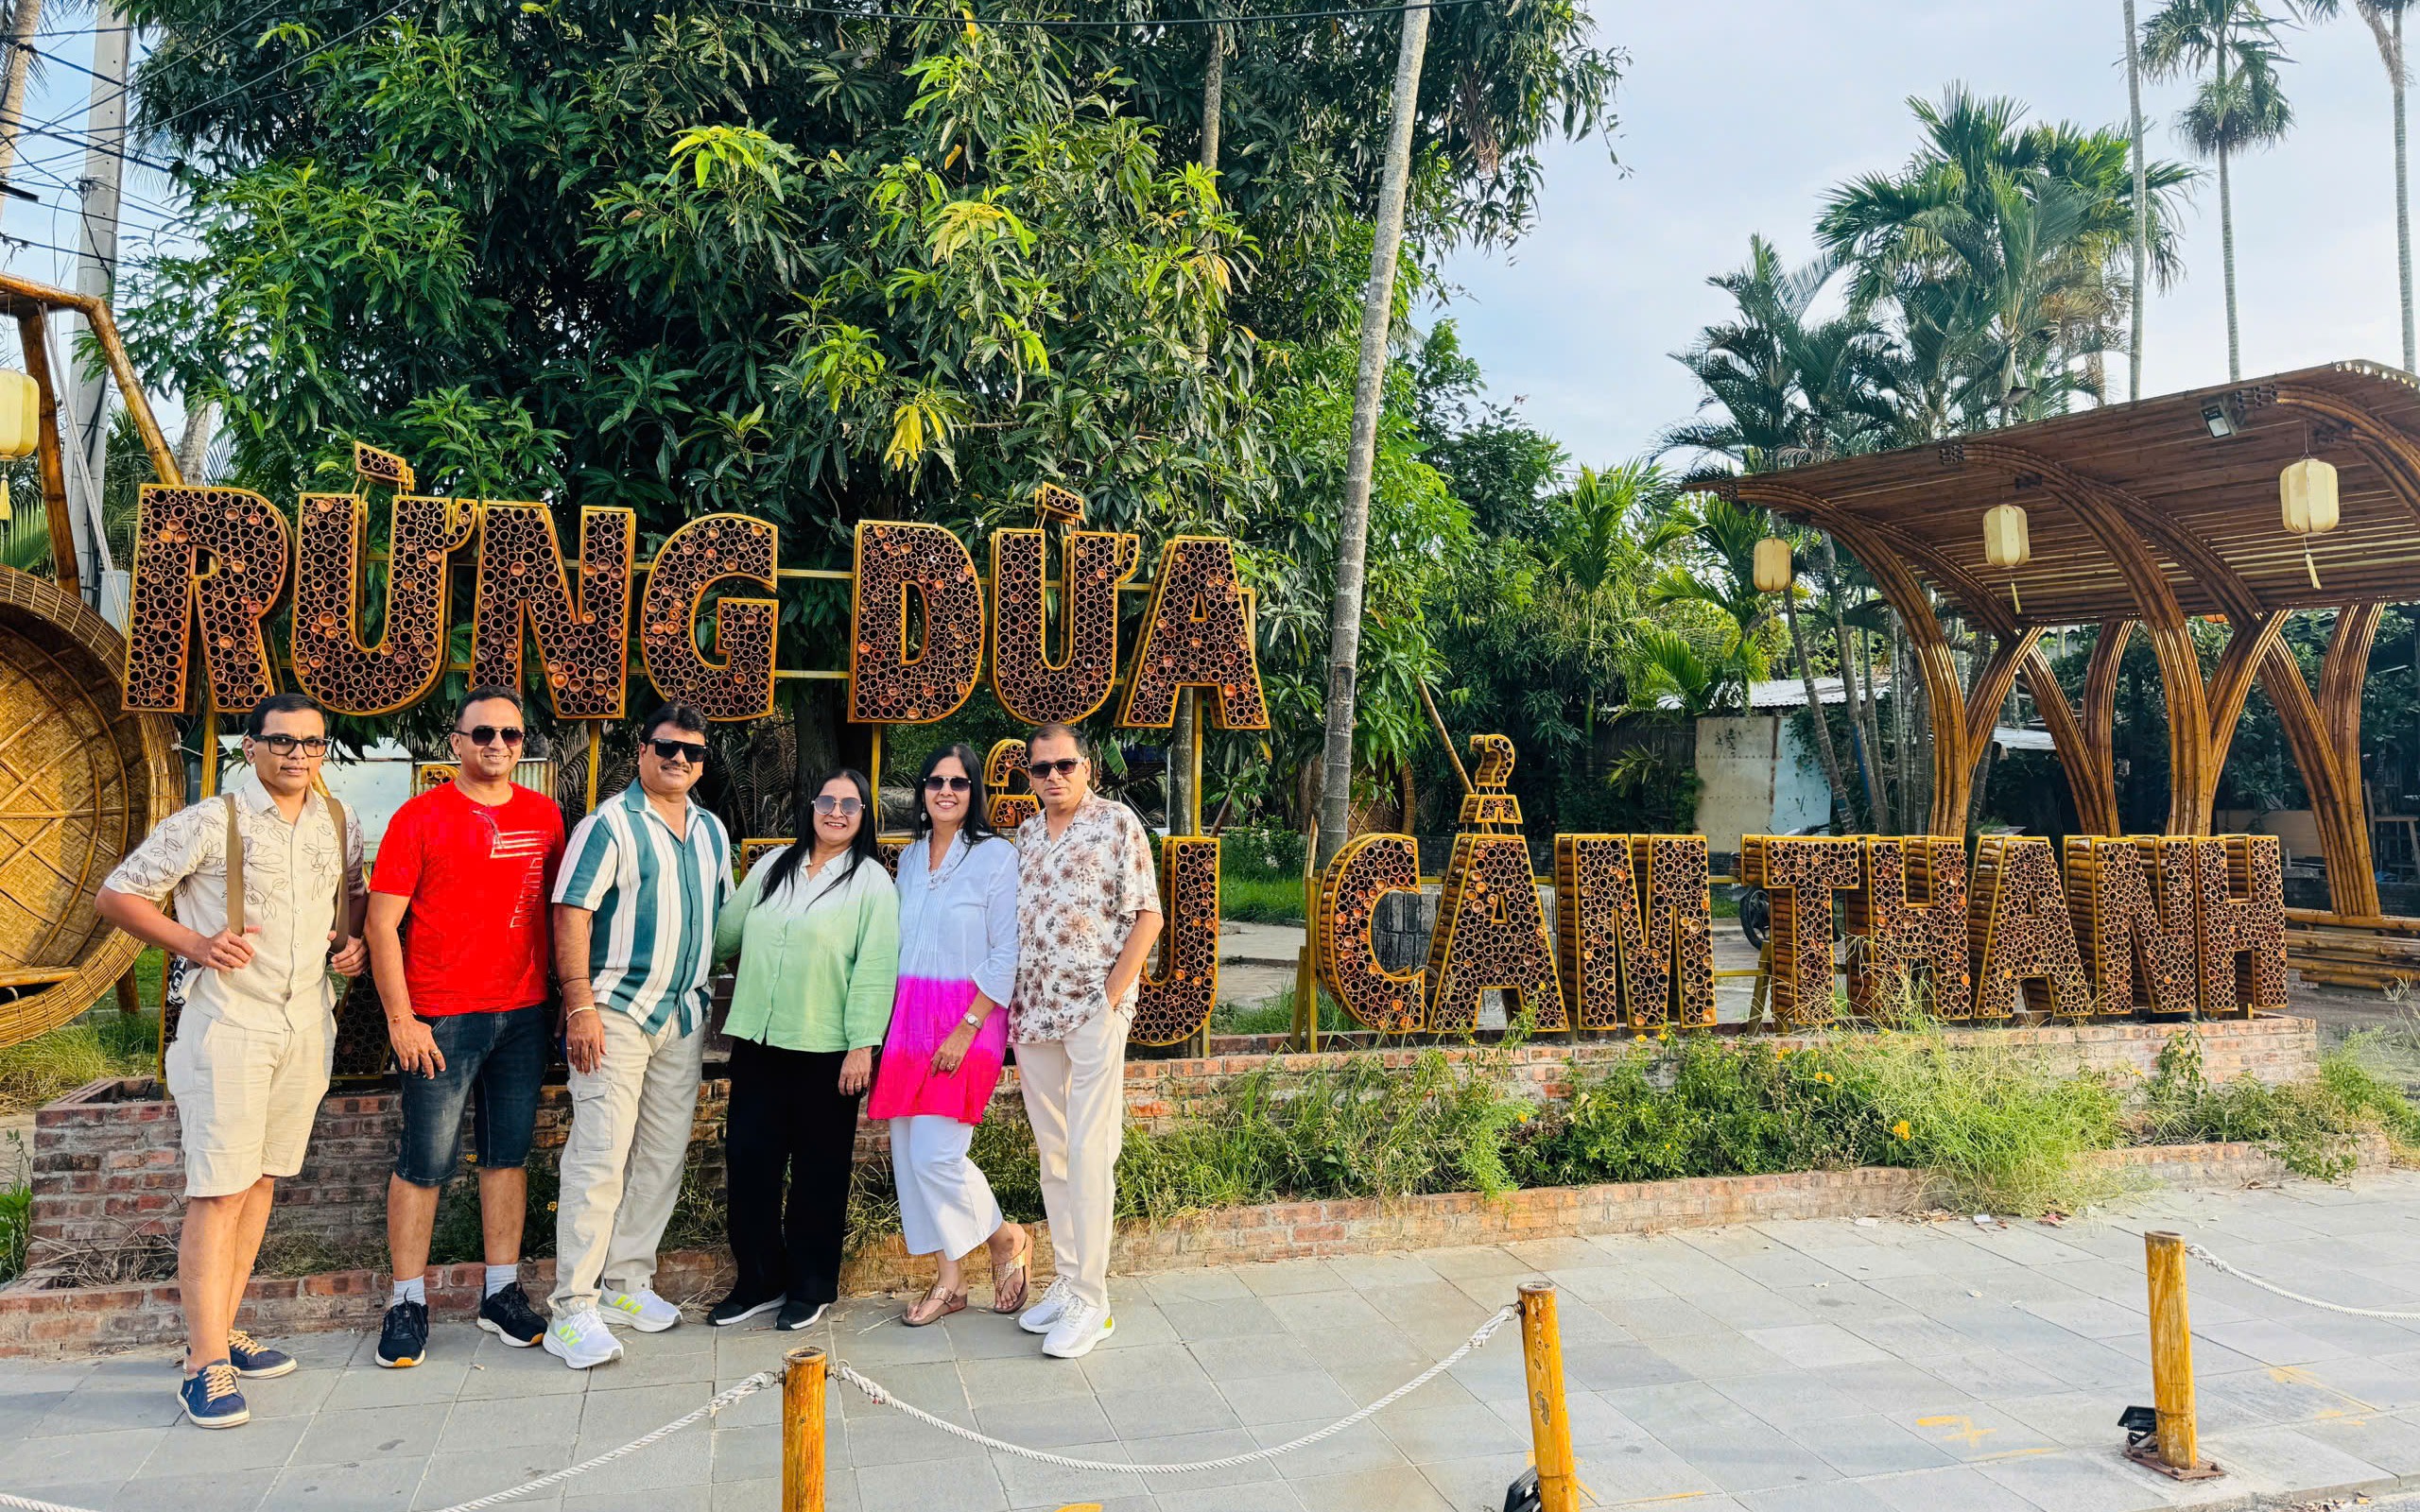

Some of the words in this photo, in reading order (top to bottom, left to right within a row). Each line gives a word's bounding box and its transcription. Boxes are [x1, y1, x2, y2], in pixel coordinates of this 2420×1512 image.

[121, 439, 779, 722] RỪNG
[848, 482, 1270, 730] DỪA
[1319, 734, 1717, 1034] CẨM
[1741, 834, 2289, 1024] THANH
